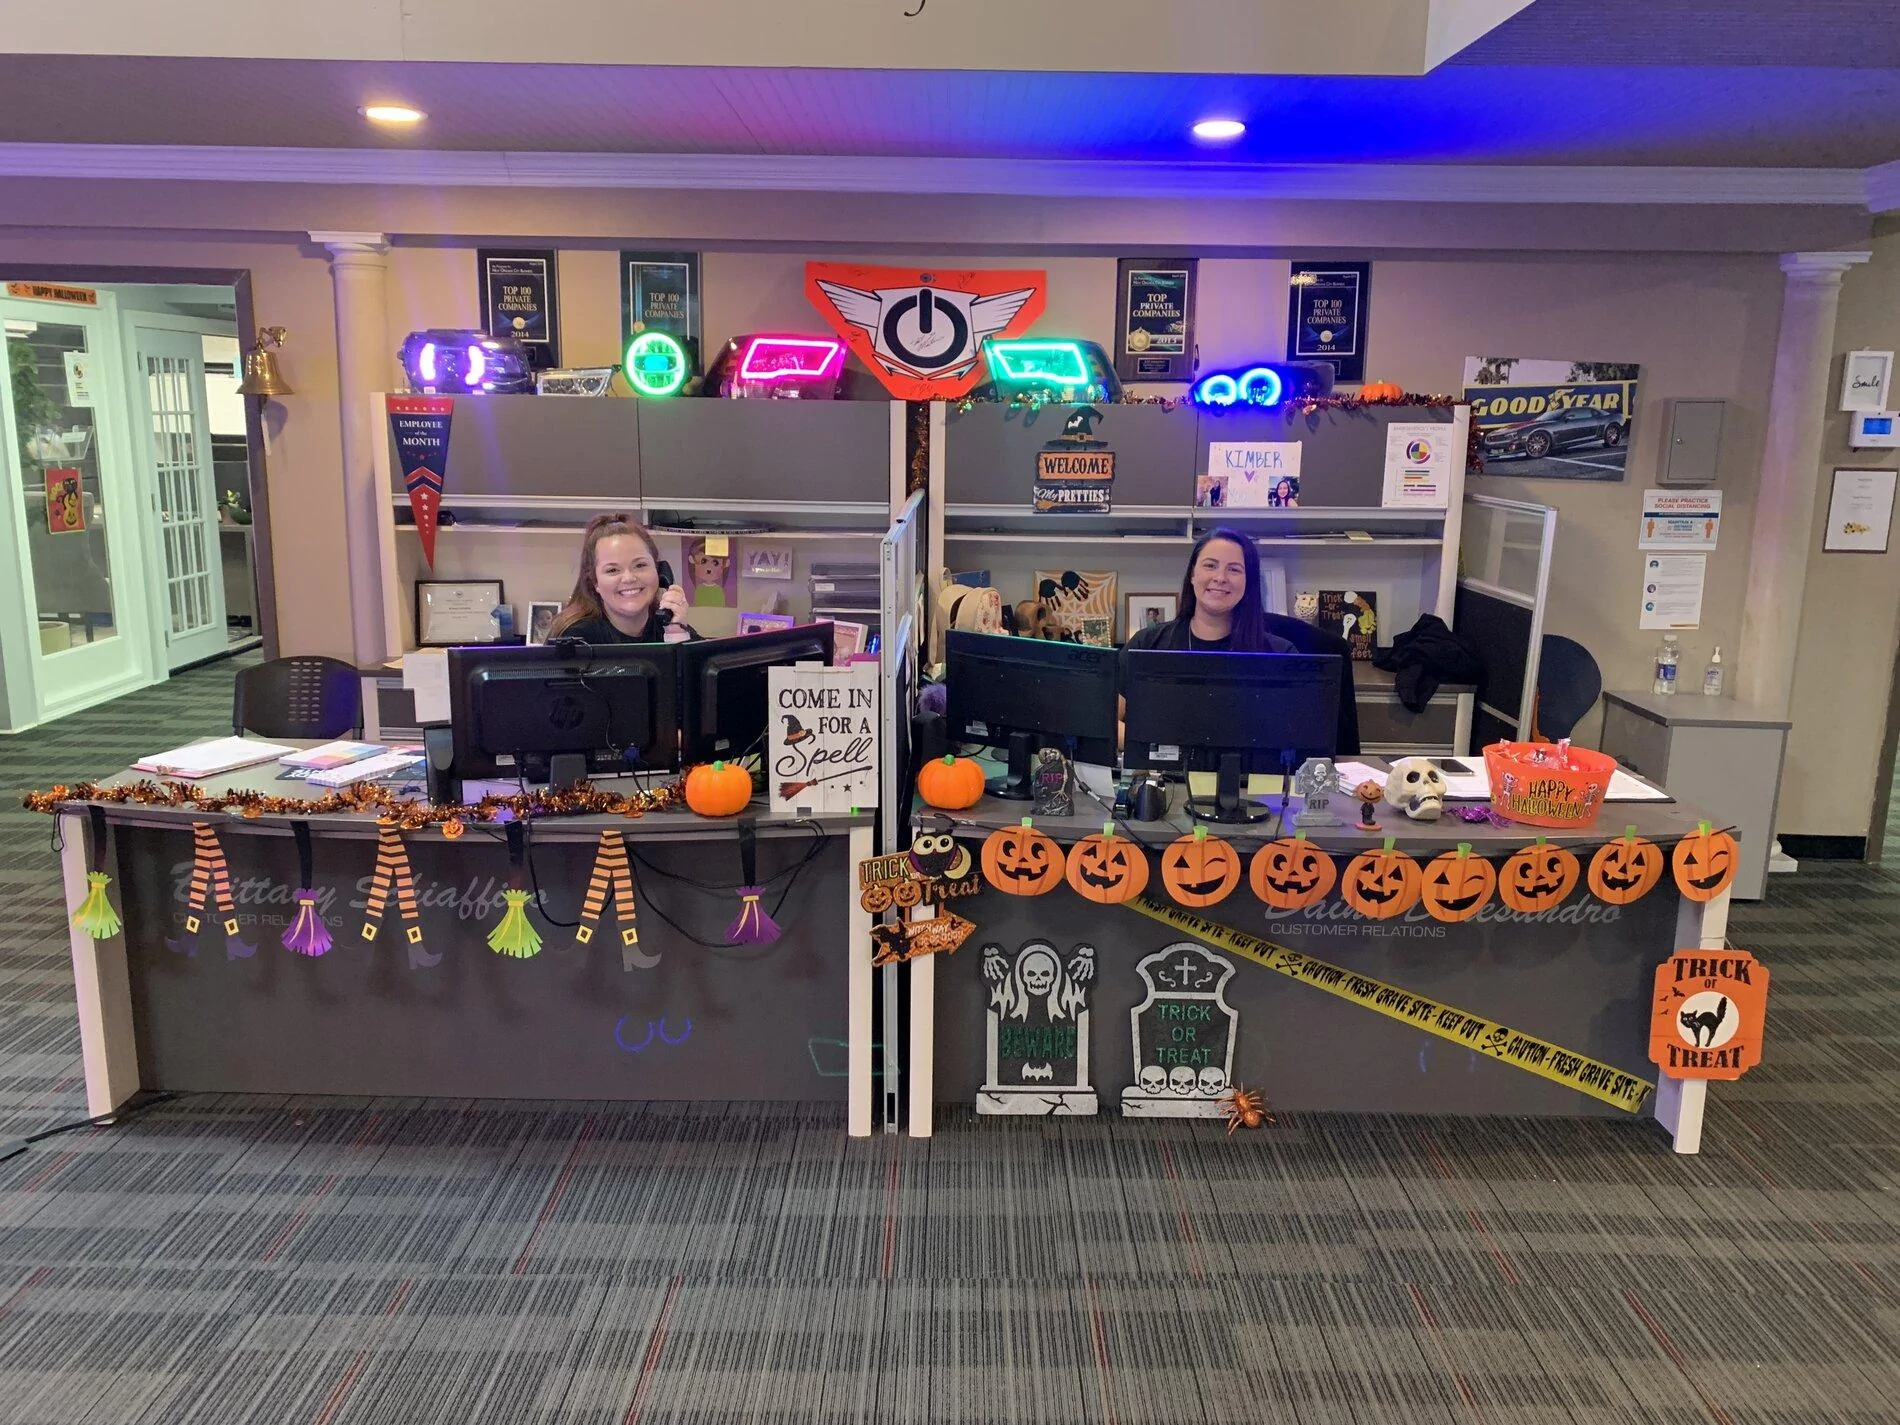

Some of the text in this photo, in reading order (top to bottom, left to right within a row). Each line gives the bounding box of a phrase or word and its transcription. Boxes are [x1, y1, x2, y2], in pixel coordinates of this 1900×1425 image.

[503, 286, 532, 295] TOP 100
[649, 292, 680, 302] TOP 100
[1147, 293, 1167, 302] TOP
[503, 295, 531, 303] PRIVATE
[650, 301, 678, 310] PRIVATE
[1140, 302, 1174, 310] PRIVATE
[1313, 299, 1342, 308] TOP 100
[498, 303, 538, 311] COMPANIES
[644, 309, 685, 319] COMPANIES
[1132, 309, 1181, 318] COMPANIES
[1313, 308, 1341, 316] PRIVATE
[1307, 316, 1347, 324] COMPANIES
[1852, 374, 1881, 389] Smile
[399, 420, 443, 429] EMPLOYEE
[402, 437, 440, 446] MONTH
[1044, 457, 1109, 475] WELCOME
[1225, 449, 1283, 469] KIMBER
[1058, 489, 1105, 502] PRETTIES
[748, 551, 789, 567] YAY!
[779, 688, 873, 709] COME IN
[818, 717, 871, 734] FOR A
[775, 734, 873, 777] Spell
[1042, 773, 1063, 783] RIP
[1529, 779, 1575, 801] HAPPY
[1309, 799, 1330, 809] RIP
[863, 856, 910, 883] TRICK
[921, 873, 982, 905] Treat
[1270, 923, 1446, 938] CUSTOMER RELATIONS
[1673, 958, 1752, 985] TRICK
[1158, 1004, 1211, 1021] TRICK
[1171, 1026, 1196, 1042] OR
[1302, 959, 1342, 986] CAUTION
[1344, 976, 1375, 999] FRESH
[1375, 986, 1413, 1013] GRAVE
[1407, 1001, 1434, 1022] SITE
[1435, 1009, 1464, 1032] KEEP
[1460, 1019, 1486, 1042] OUT
[1506, 1035, 1550, 1067] CAUTION
[1549, 1050, 1581, 1077] FRESH
[1578, 1062, 1615, 1092] GRAVE
[1610, 1074, 1639, 1101] SITE
[1002, 1025, 1077, 1058] BEWARE
[1156, 1047, 1211, 1065] TREAT
[1667, 1043, 1745, 1068] TREAT
